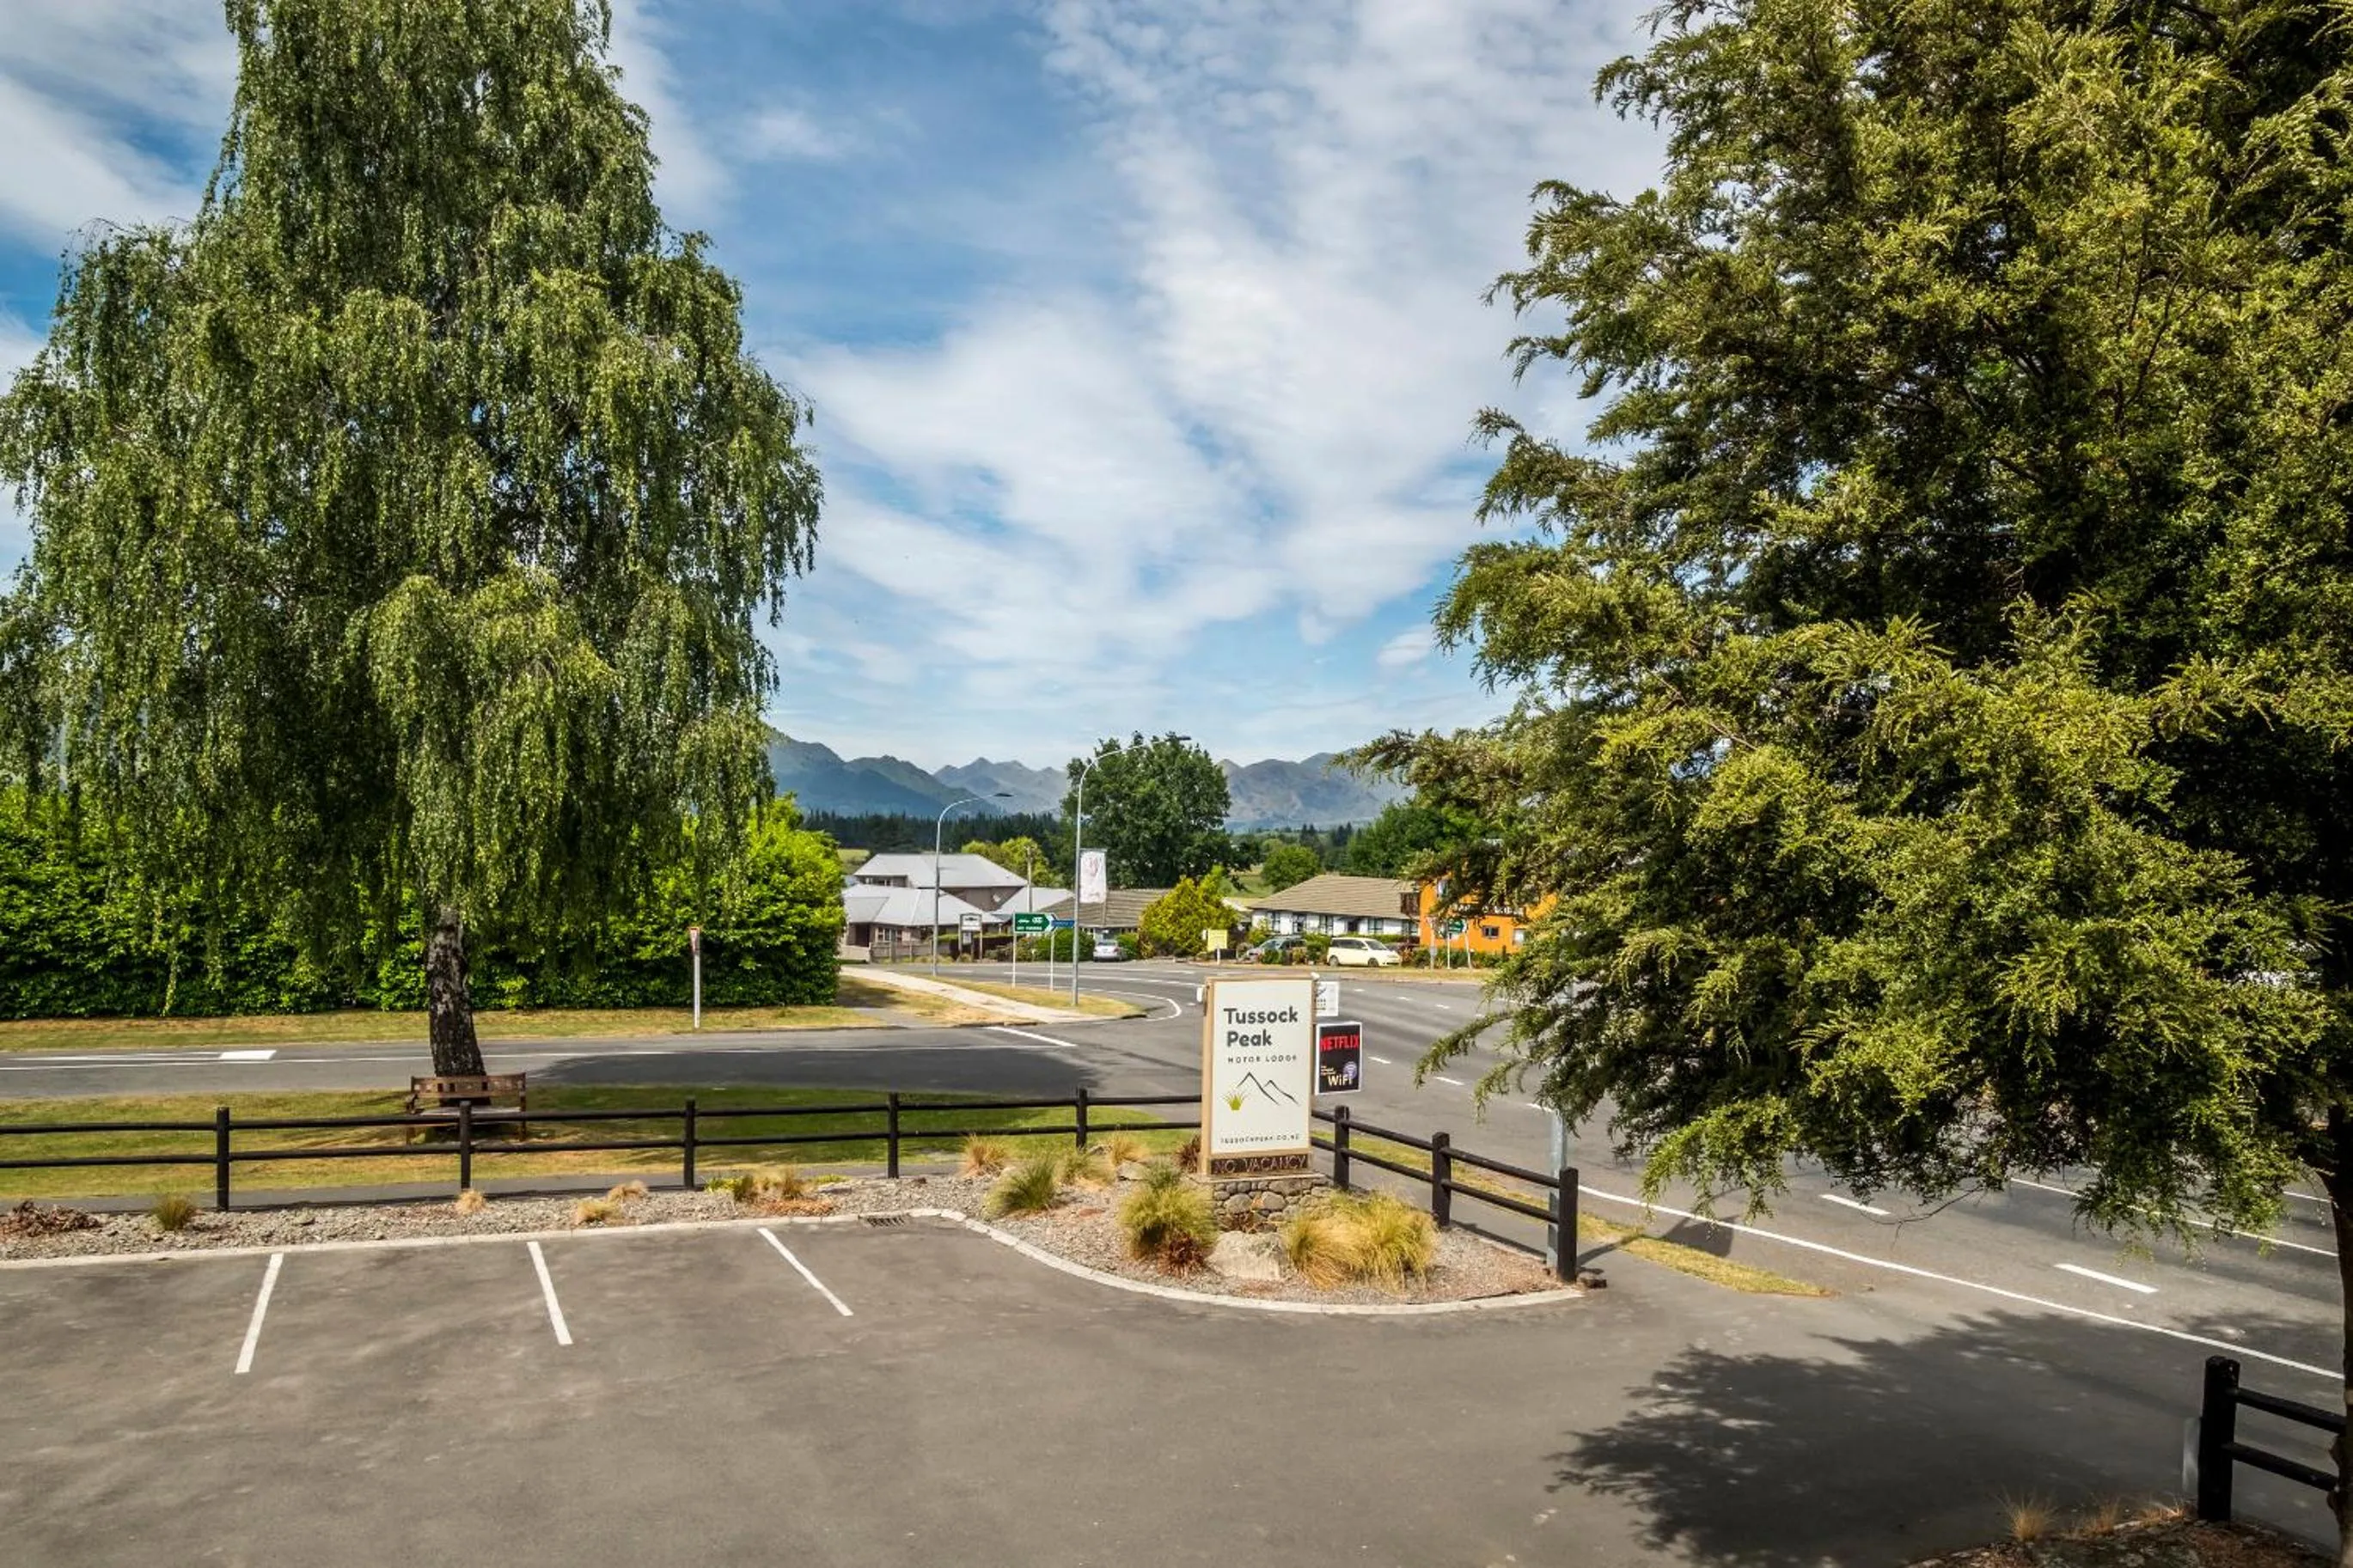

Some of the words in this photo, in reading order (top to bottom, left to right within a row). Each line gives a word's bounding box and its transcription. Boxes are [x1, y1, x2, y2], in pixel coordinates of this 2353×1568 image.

[1223, 1006, 1299, 1025] Tussock
[1226, 1028, 1273, 1047] Peak
[1320, 1034, 1360, 1052] NETFLIX
[1244, 1155, 1306, 1172] VACANCY
